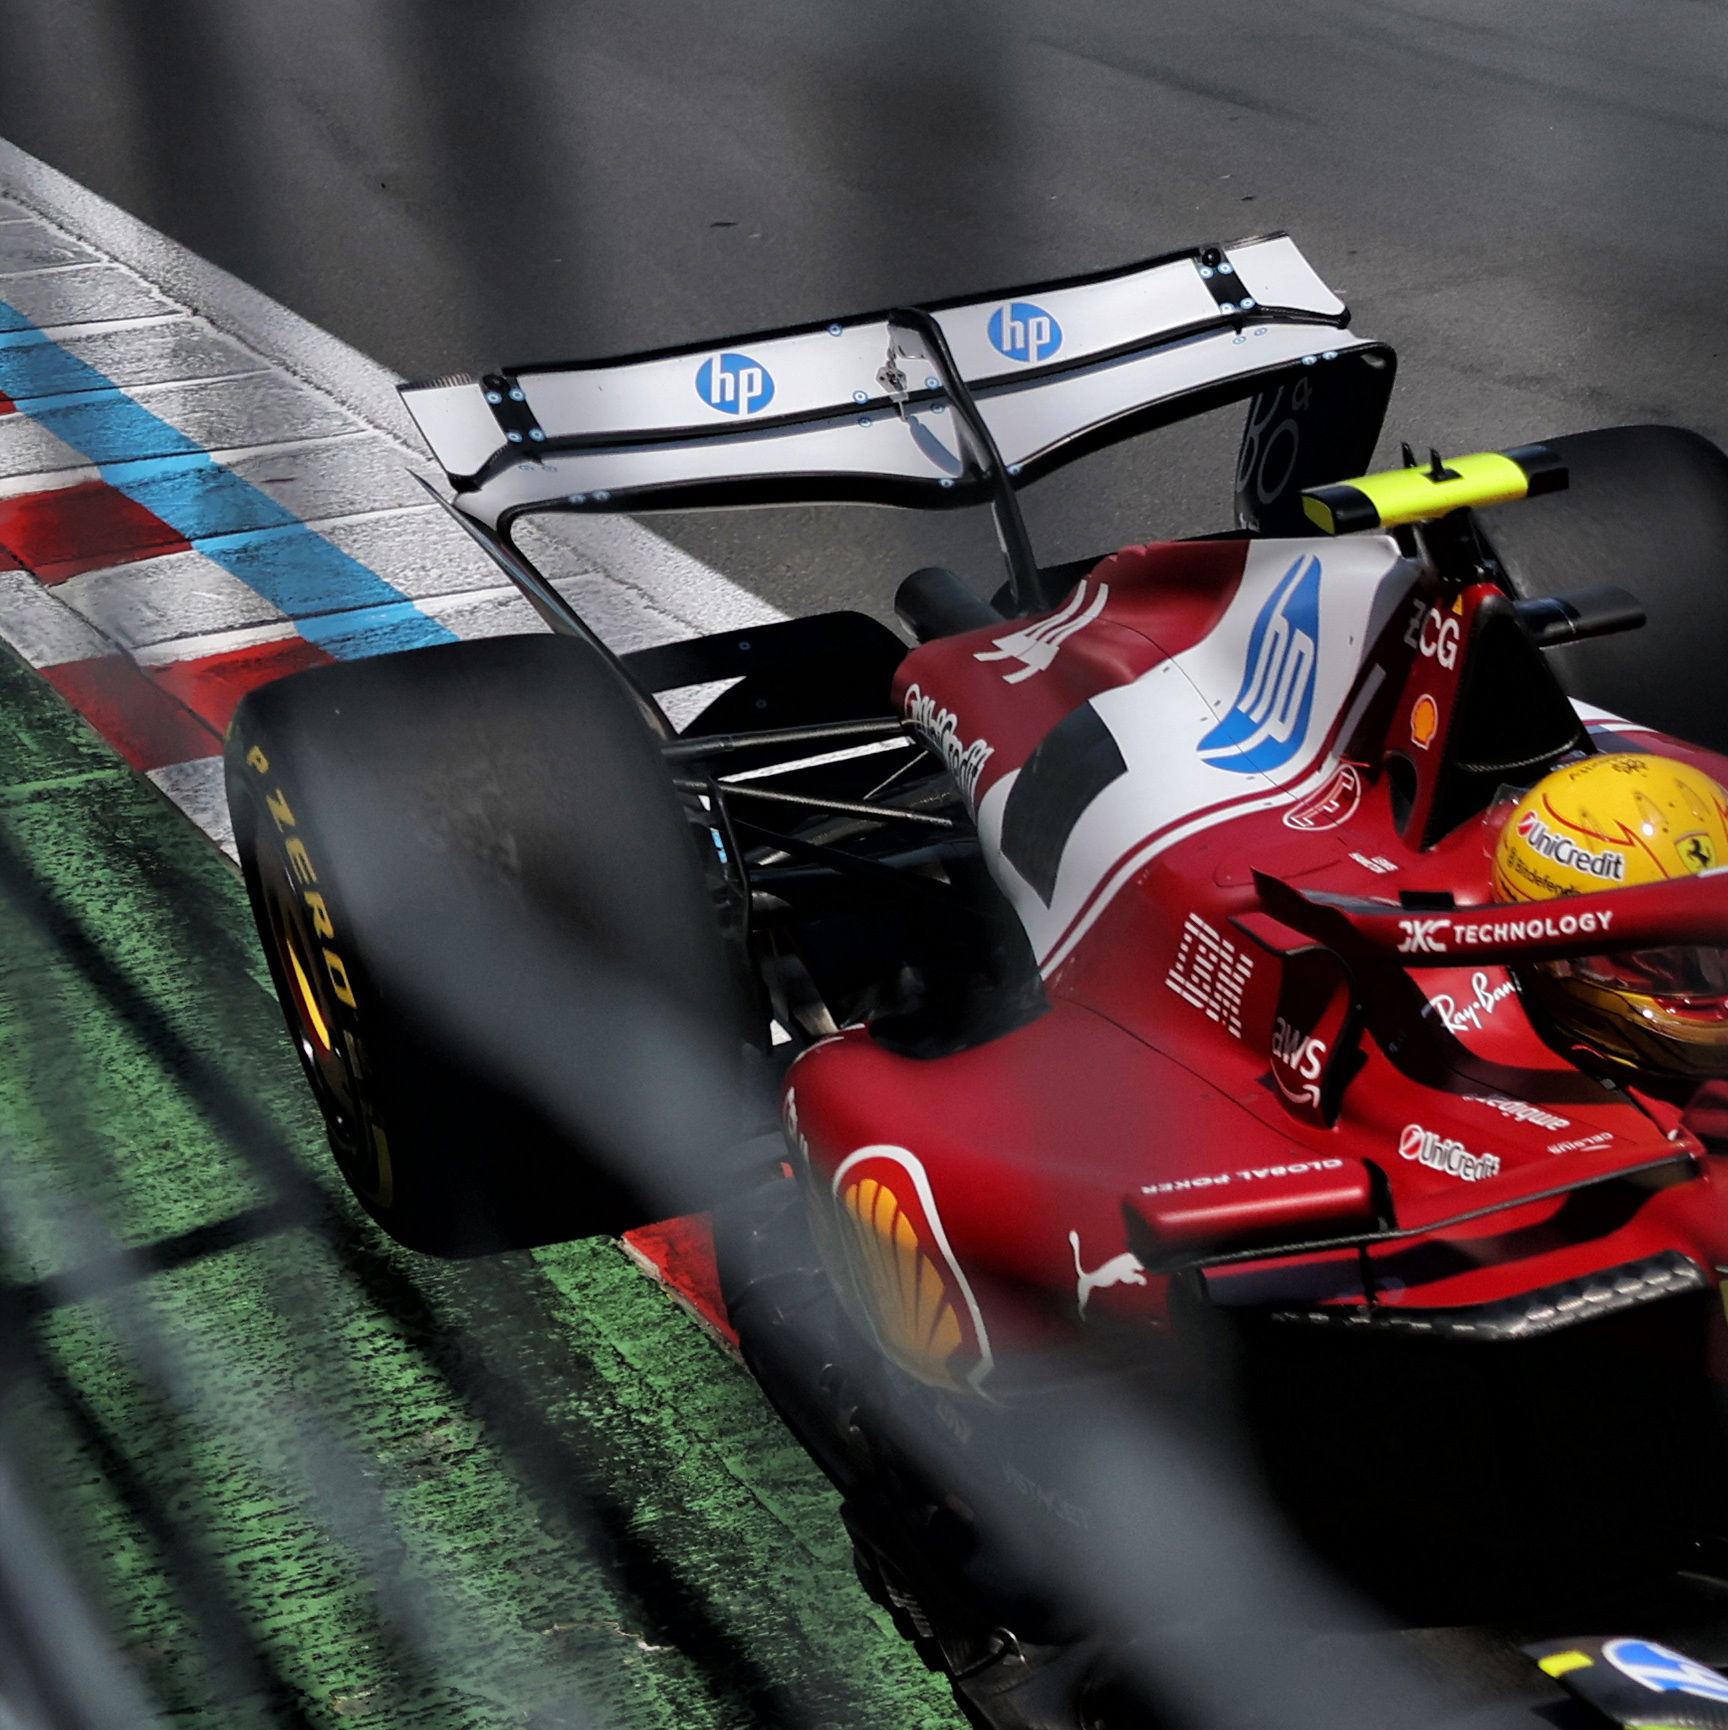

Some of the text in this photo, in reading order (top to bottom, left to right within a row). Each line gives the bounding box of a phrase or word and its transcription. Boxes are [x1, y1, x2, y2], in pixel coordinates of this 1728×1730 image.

[1197, 554, 1316, 762] hp
[1404, 599, 1460, 670] ZCG
[246, 745, 269, 775] P
[265, 788, 358, 1010] ZERO
[1528, 822, 1623, 880] UniCredit
[1397, 911, 1613, 951] DXC TECHNOLOGY
[1165, 912, 1255, 1040] IBM
[1140, 1157, 1343, 1197] GLOBAL POKER
[1420, 1130, 1500, 1181] UniCredit
